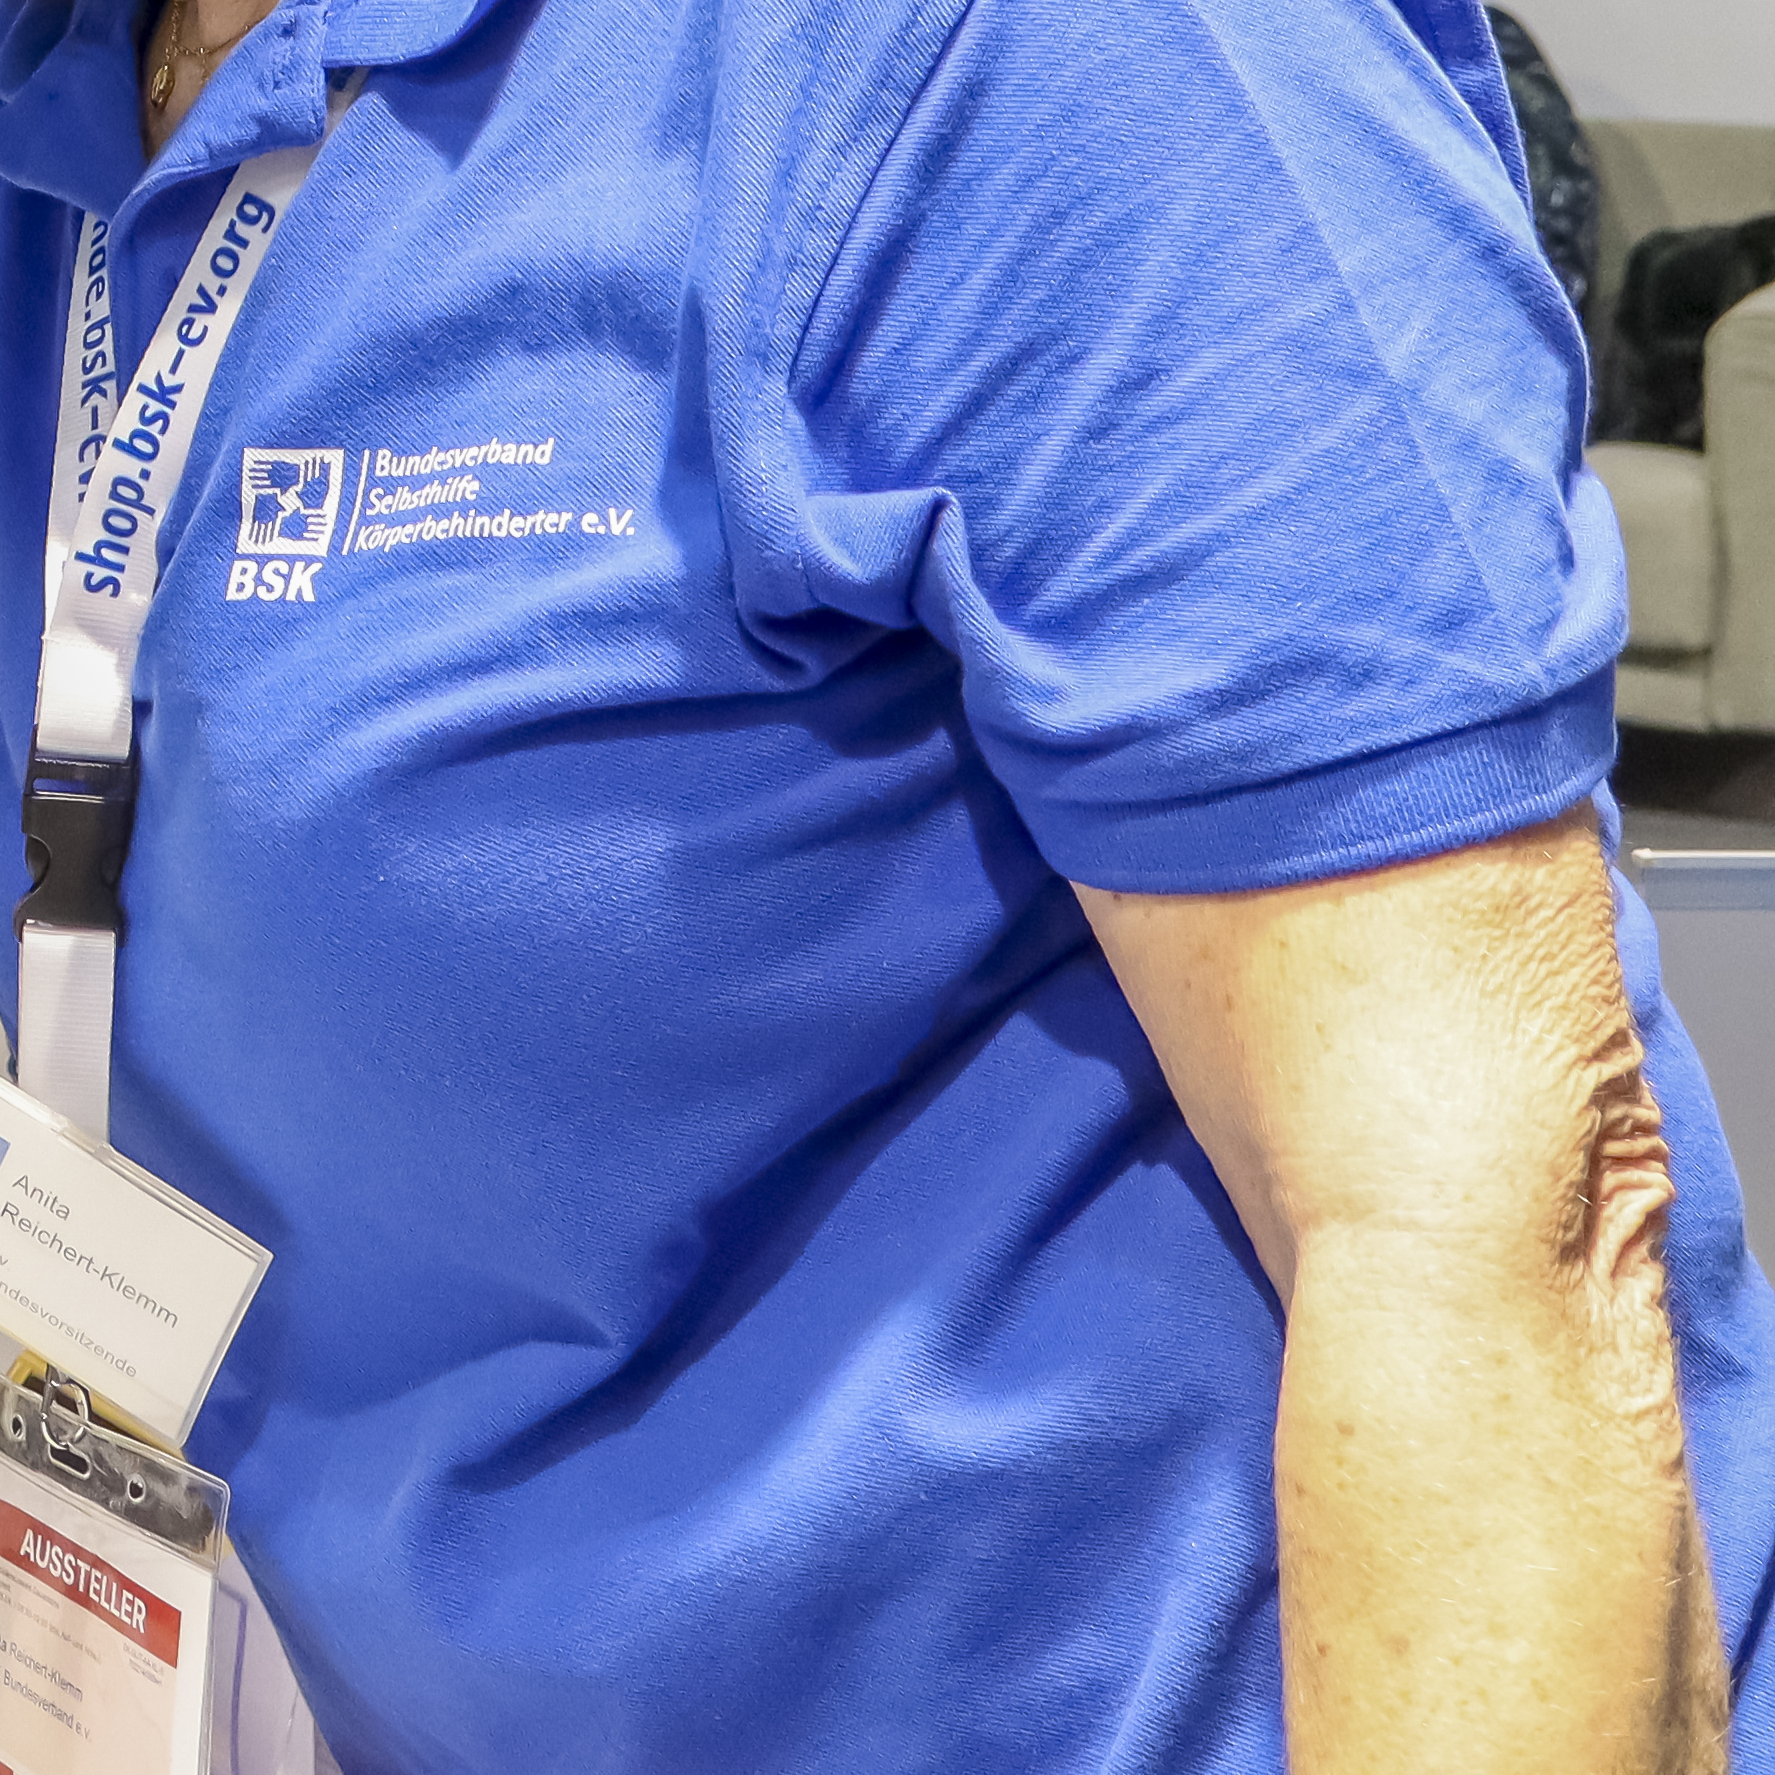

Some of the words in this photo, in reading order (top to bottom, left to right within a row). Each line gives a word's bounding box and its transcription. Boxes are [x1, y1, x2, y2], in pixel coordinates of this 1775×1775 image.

[74, 191, 277, 599] shop.bsk-ev.org
[374, 437, 555, 478] Bundesverband
[366, 474, 480, 516] Selbsthilfe
[354, 508, 572, 554] Körperbehinderter
[581, 507, 635, 537] e.V.
[225, 559, 324, 603] BSK
[11, 1173, 72, 1222] Anita
[0, 1201, 180, 1329] Reichert-Klemm
[19, 1527, 148, 1635] AUSSTELLER
[9, 1640, 83, 1704] Reichert-Klemm
[3, 1671, 74, 1730] Bundesverband
